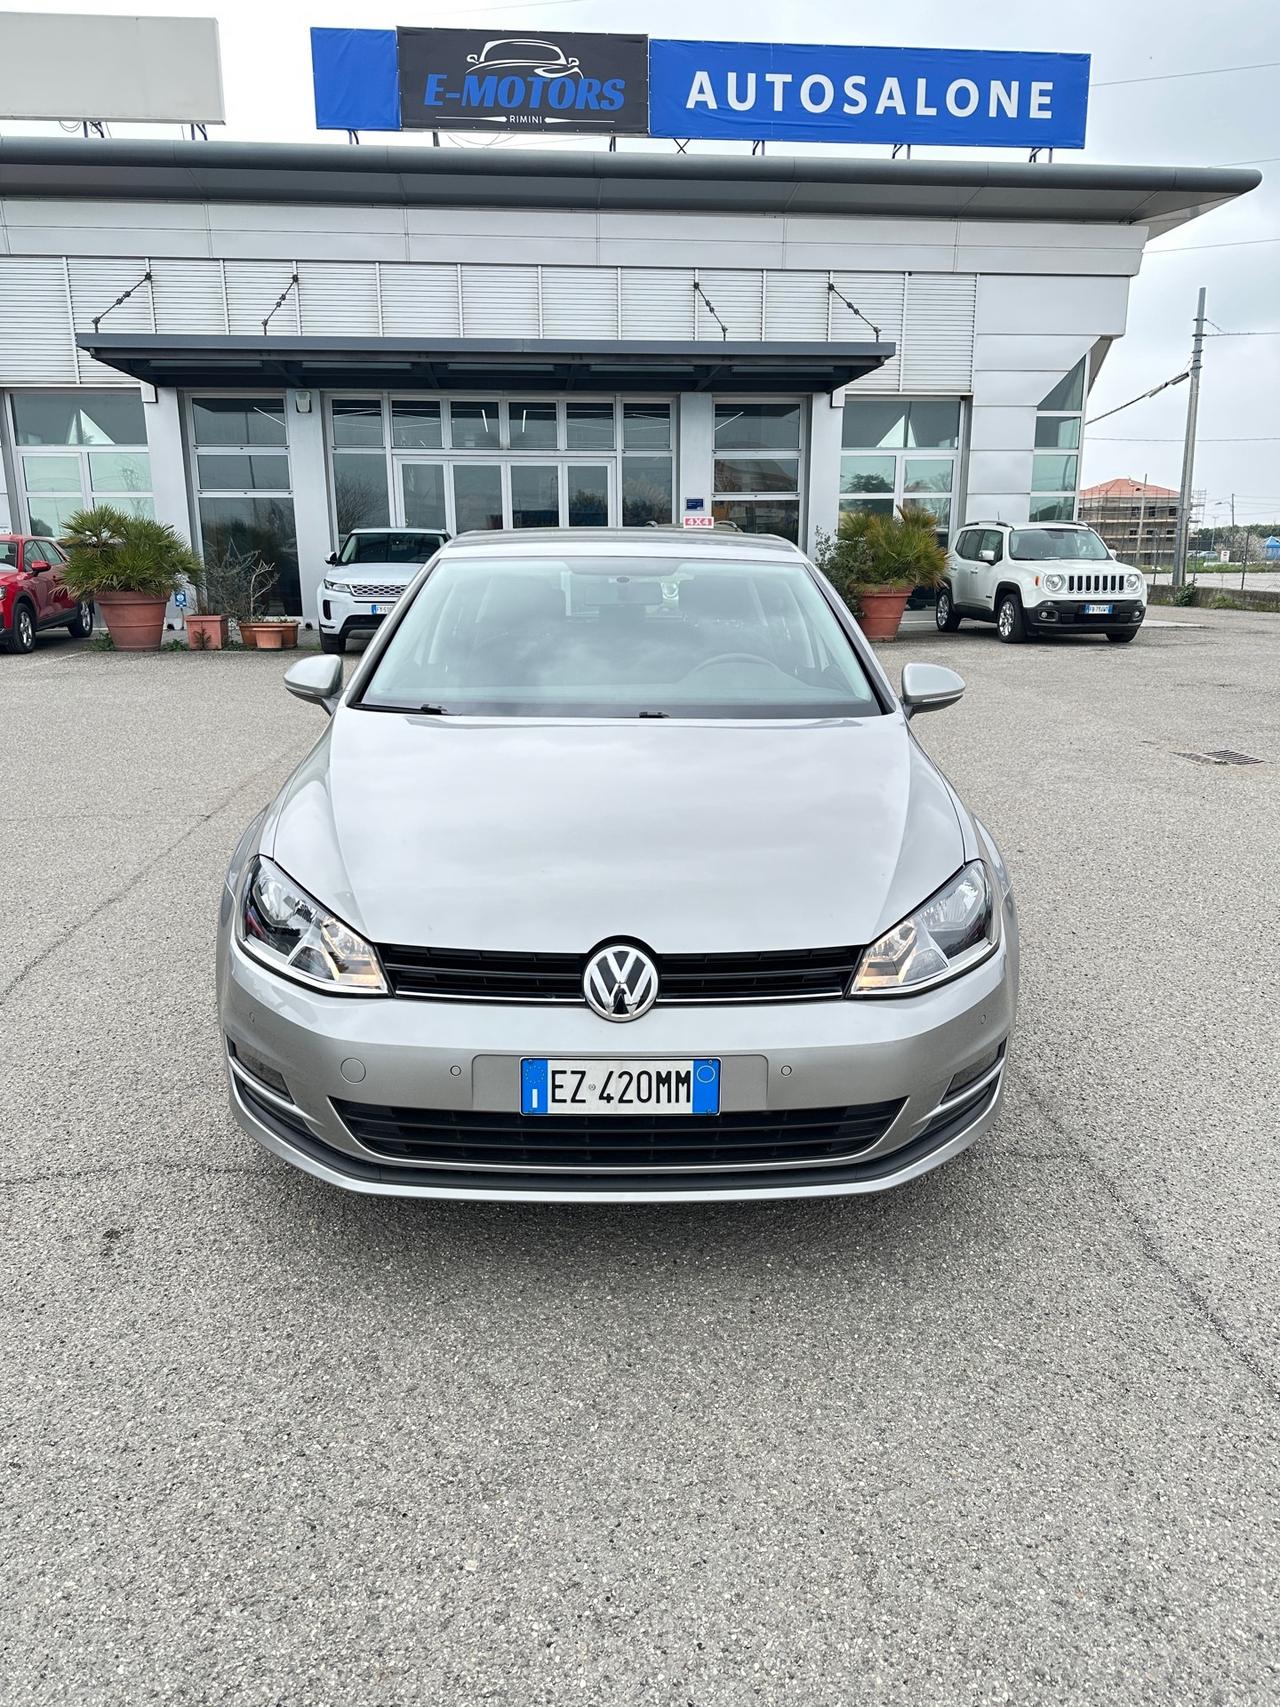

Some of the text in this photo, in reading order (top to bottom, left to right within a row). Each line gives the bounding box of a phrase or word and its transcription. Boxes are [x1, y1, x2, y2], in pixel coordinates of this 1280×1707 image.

[424, 73, 626, 111] E-MOTORS
[685, 70, 1055, 120] AUTOSALONE
[509, 115, 543, 124] RIMINI
[551, 1070, 691, 1103] EZ 420MM
